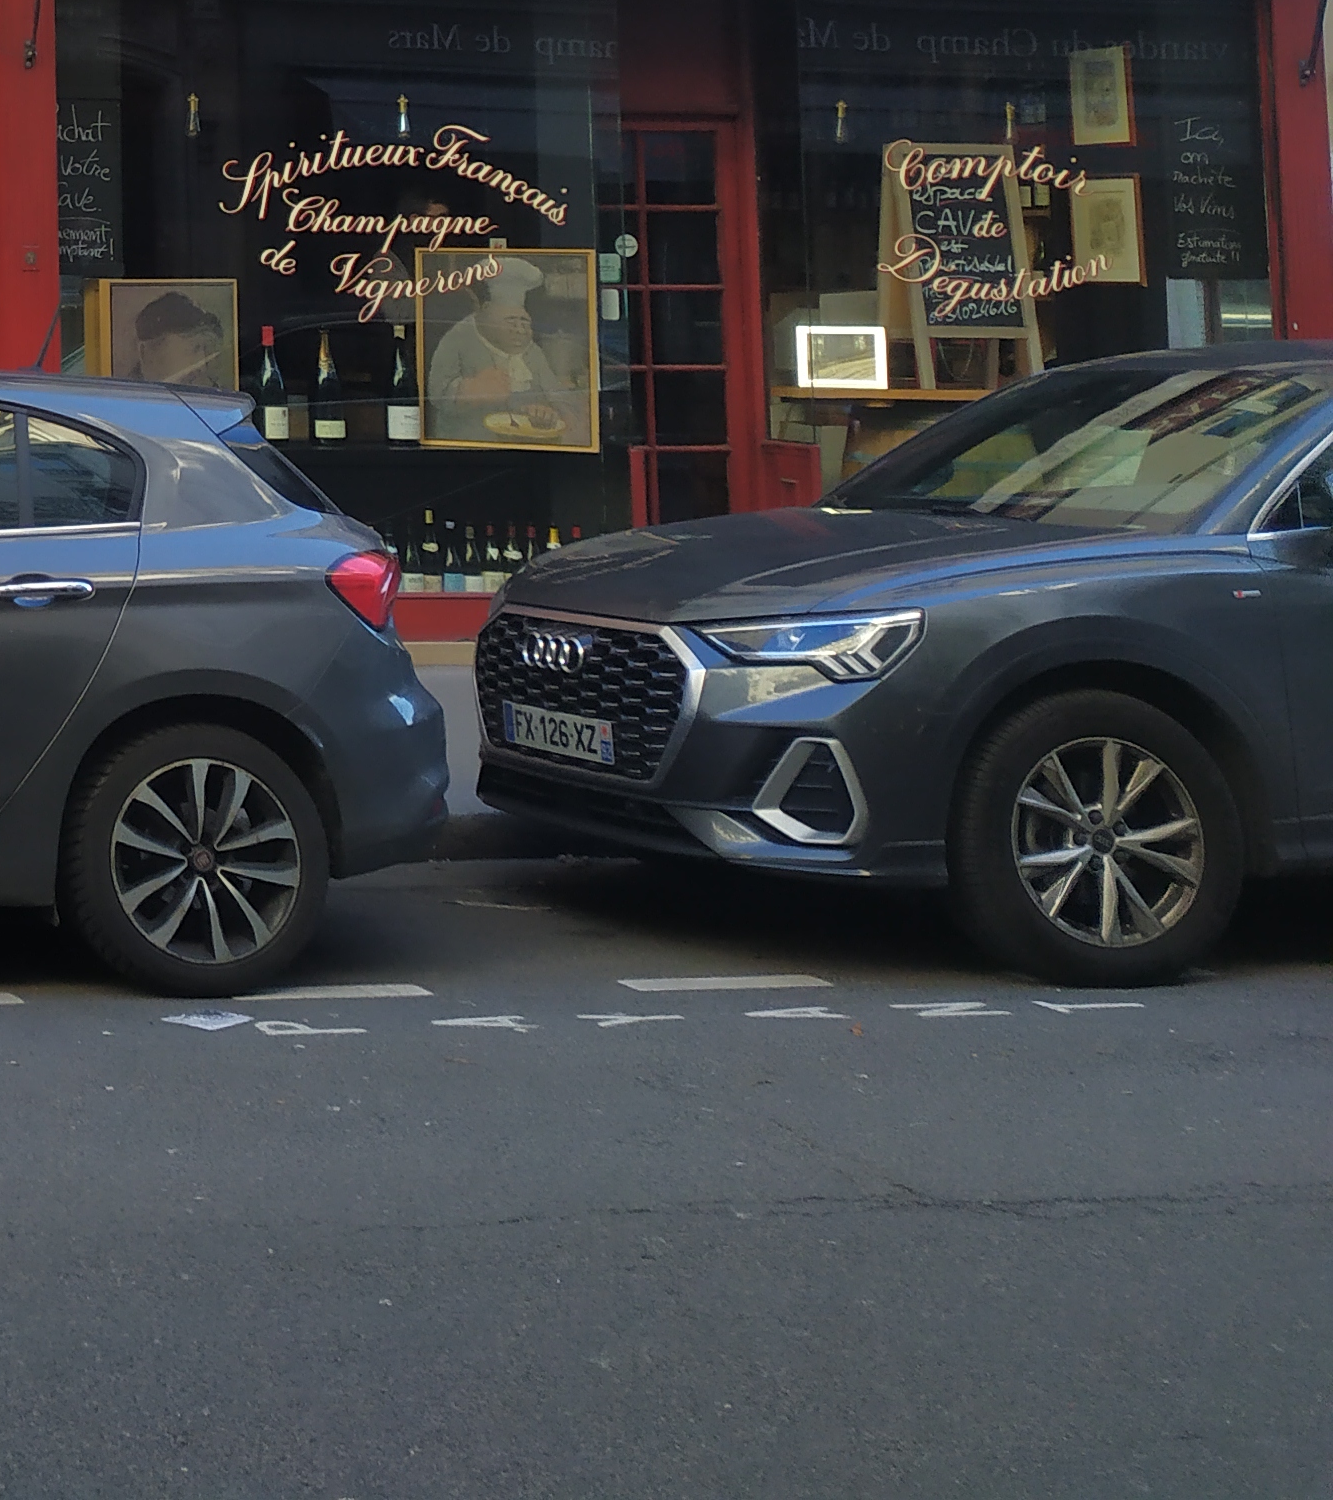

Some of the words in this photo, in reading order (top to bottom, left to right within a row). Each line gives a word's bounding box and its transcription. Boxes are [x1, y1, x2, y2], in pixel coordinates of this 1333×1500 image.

[56, 103, 112, 143] achat
[60, 149, 112, 181] Votre
[219, 129, 426, 220] Spiritueux
[425, 124, 571, 226] Français
[885, 139, 1094, 197] Comptoir
[282, 187, 499, 254] Champagne
[260, 240, 297, 275] de
[330, 253, 504, 323] Vignerons
[878, 233, 1113, 318] Degustation
